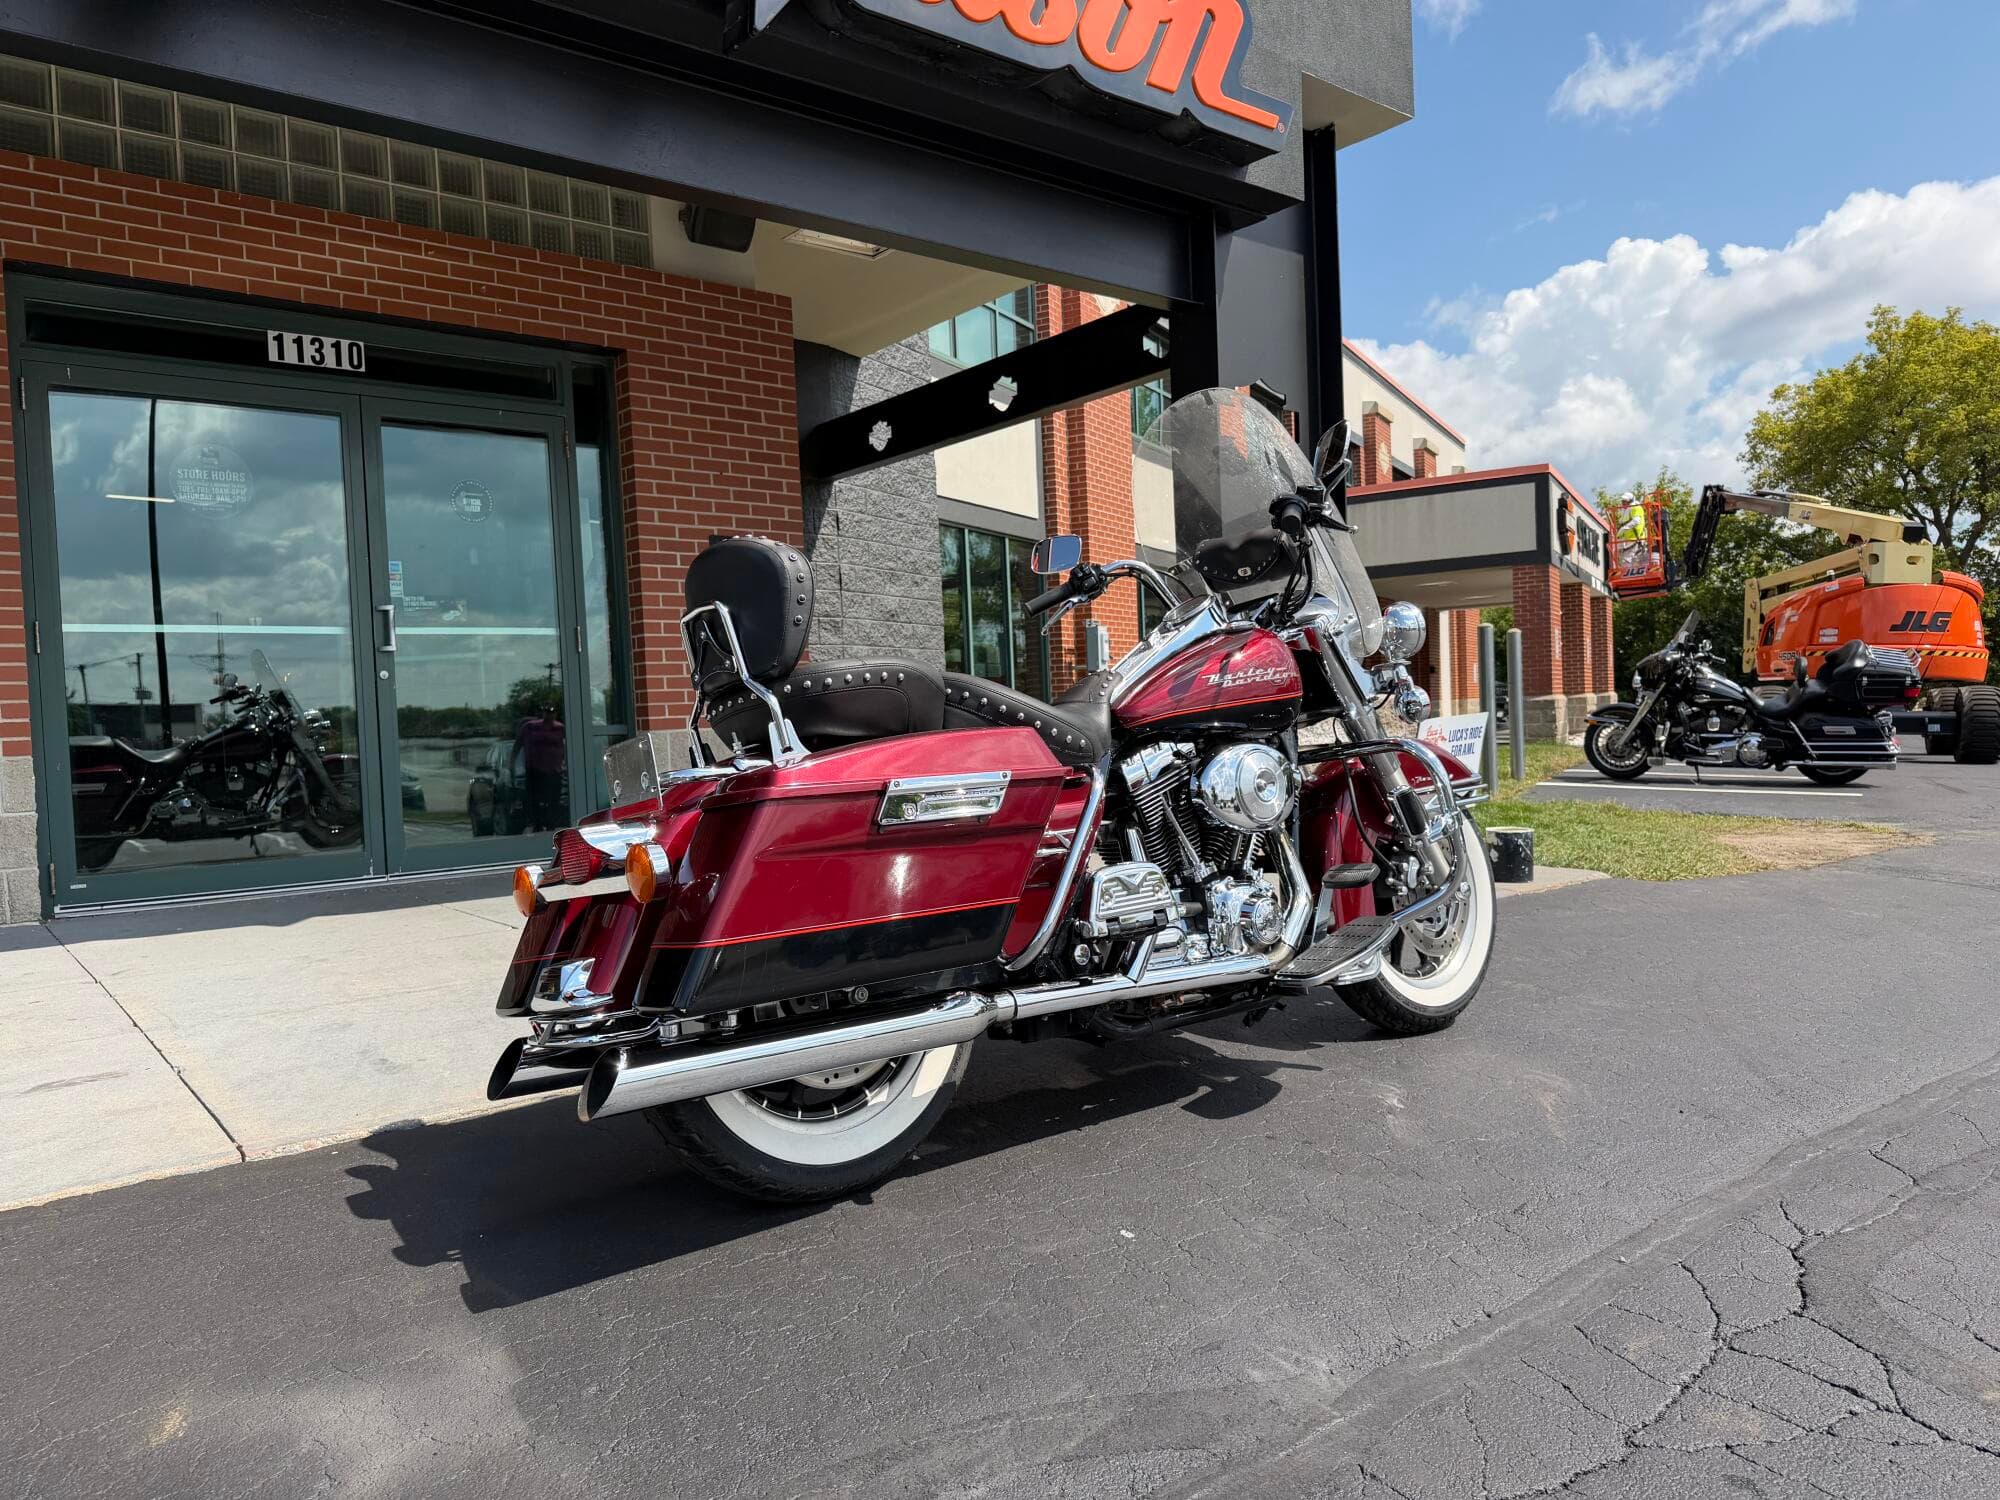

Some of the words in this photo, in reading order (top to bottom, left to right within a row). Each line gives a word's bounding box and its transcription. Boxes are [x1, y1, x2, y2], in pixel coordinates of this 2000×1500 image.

[272, 332, 363, 370] 11310
[177, 467, 209, 480] STORE
[211, 469, 246, 482] HOURS
[1623, 567, 1646, 578] JLG
[1888, 610, 1953, 633] JLG
[1203, 666, 1287, 687] Harley
[1221, 671, 1298, 688] Davidson
[1448, 727, 1469, 743] LUCA'S
[1469, 726, 1483, 739] RIDE
[1451, 744, 1463, 757] FOR
[1462, 742, 1475, 756] AML
